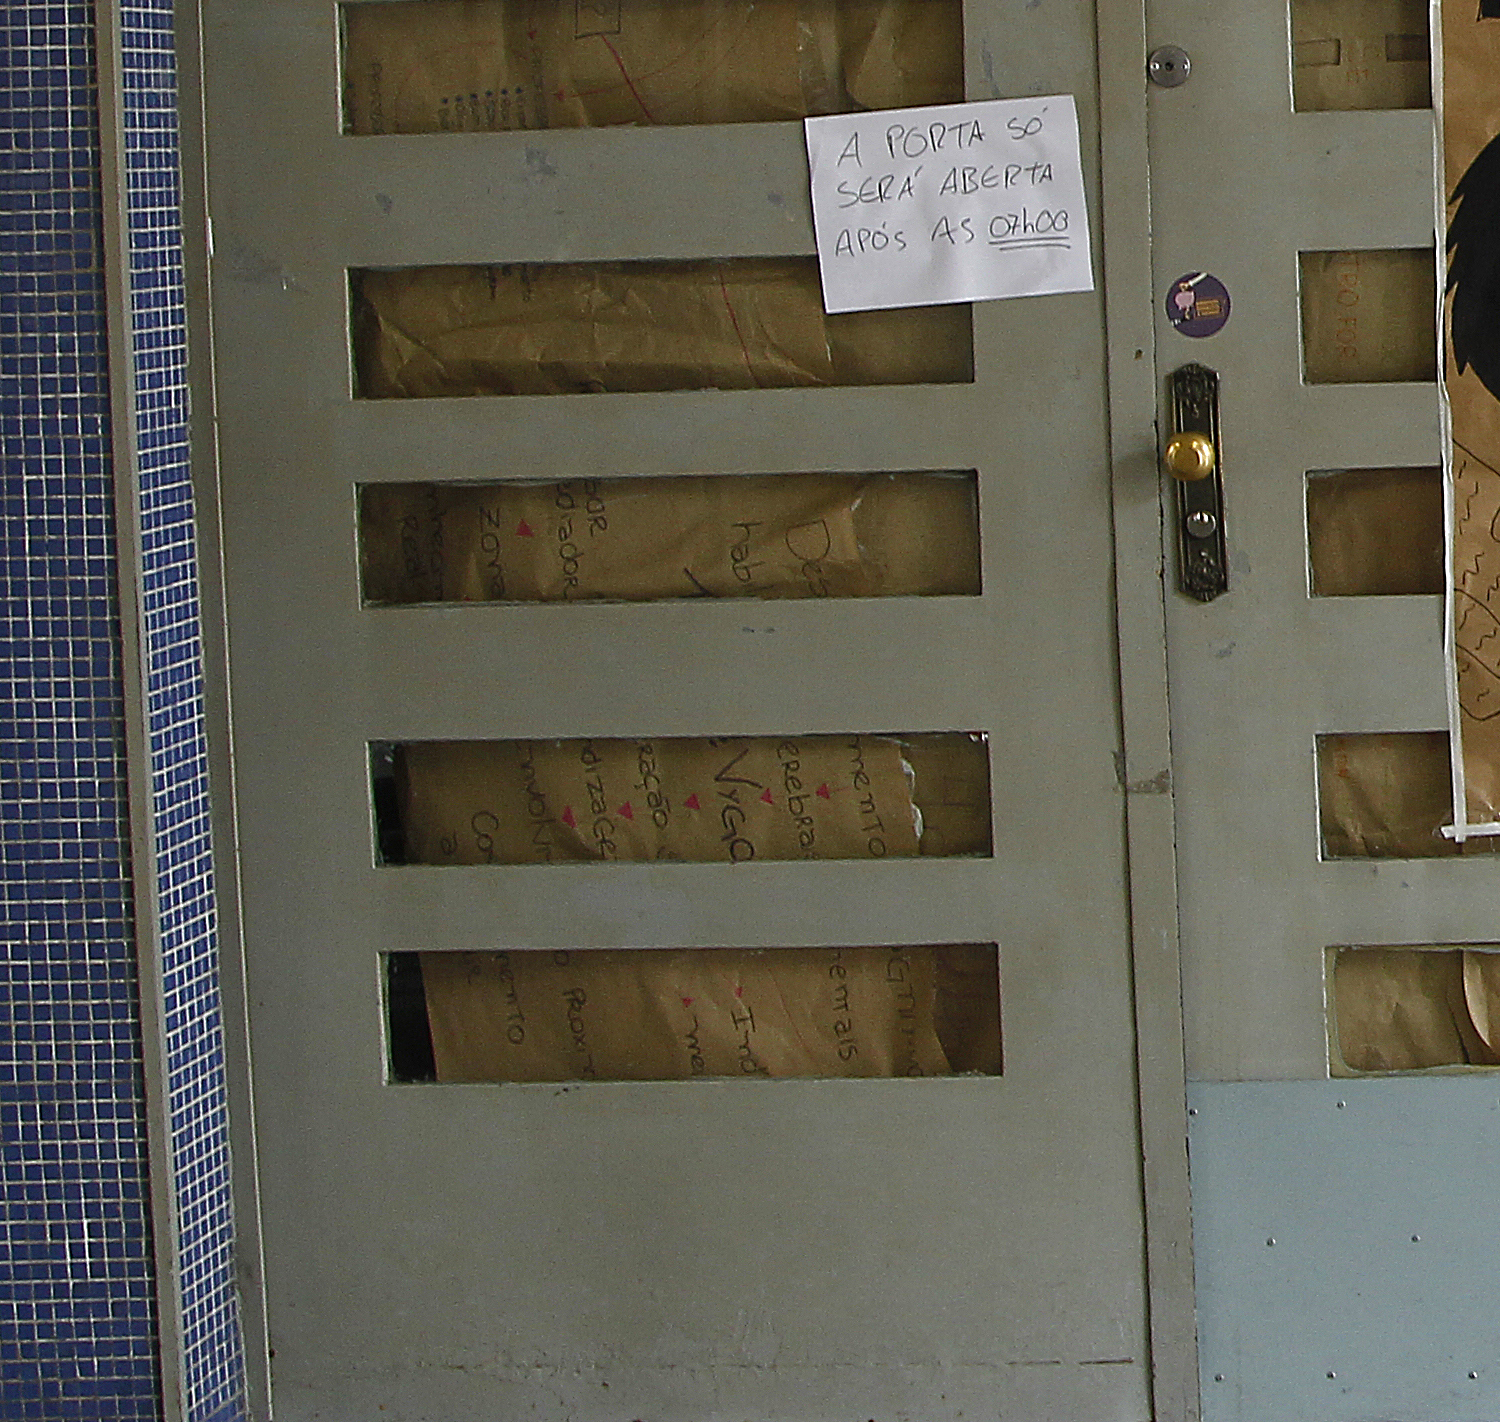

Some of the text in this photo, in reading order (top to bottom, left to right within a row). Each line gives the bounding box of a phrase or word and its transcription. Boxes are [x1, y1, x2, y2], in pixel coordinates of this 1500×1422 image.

[836, 105, 1049, 168] A PORTA SÓ
[836, 162, 1054, 209] SERÁ ABERTA
[834, 223, 908, 258] APÓS
[931, 215, 977, 245] AS
